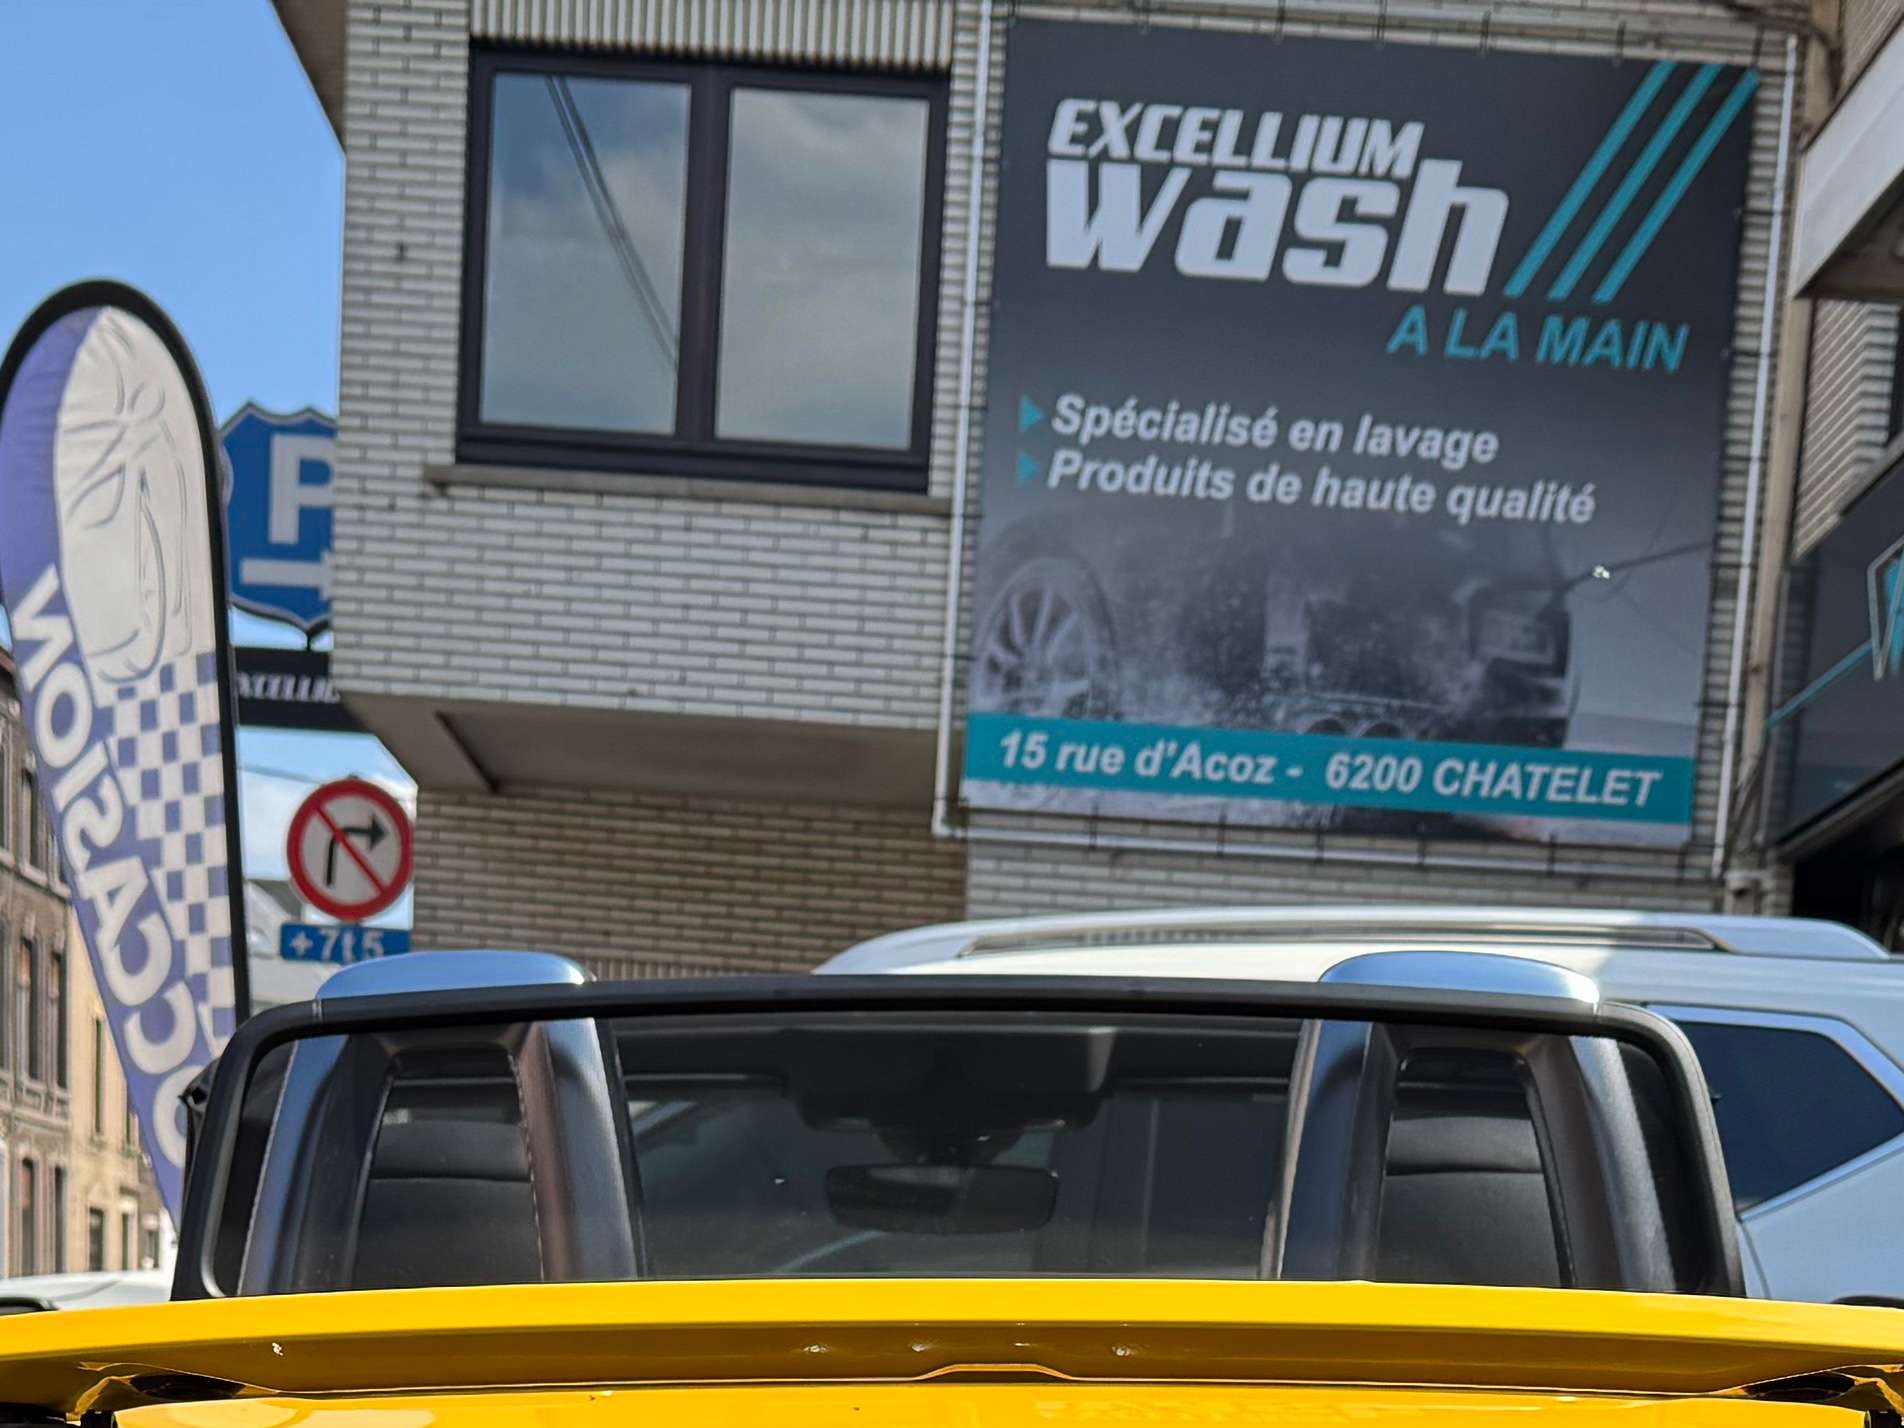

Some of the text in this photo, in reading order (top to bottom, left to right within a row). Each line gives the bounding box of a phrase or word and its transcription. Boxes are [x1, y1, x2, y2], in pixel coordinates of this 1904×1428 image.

[1047, 98, 1425, 178] EXCELLIUM
[1387, 307, 1689, 370] A LA MAIN
[1052, 396, 1500, 470] Spécialisé en lavage
[268, 434, 335, 544] P
[1047, 451, 1596, 526] Produits de haute qualité
[1000, 731, 1047, 769] 15
[1057, 745, 1123, 776] rue
[1135, 737, 1275, 784] d'Acoz
[1325, 754, 1423, 793] 6200
[1432, 760, 1661, 806] CHATELET
